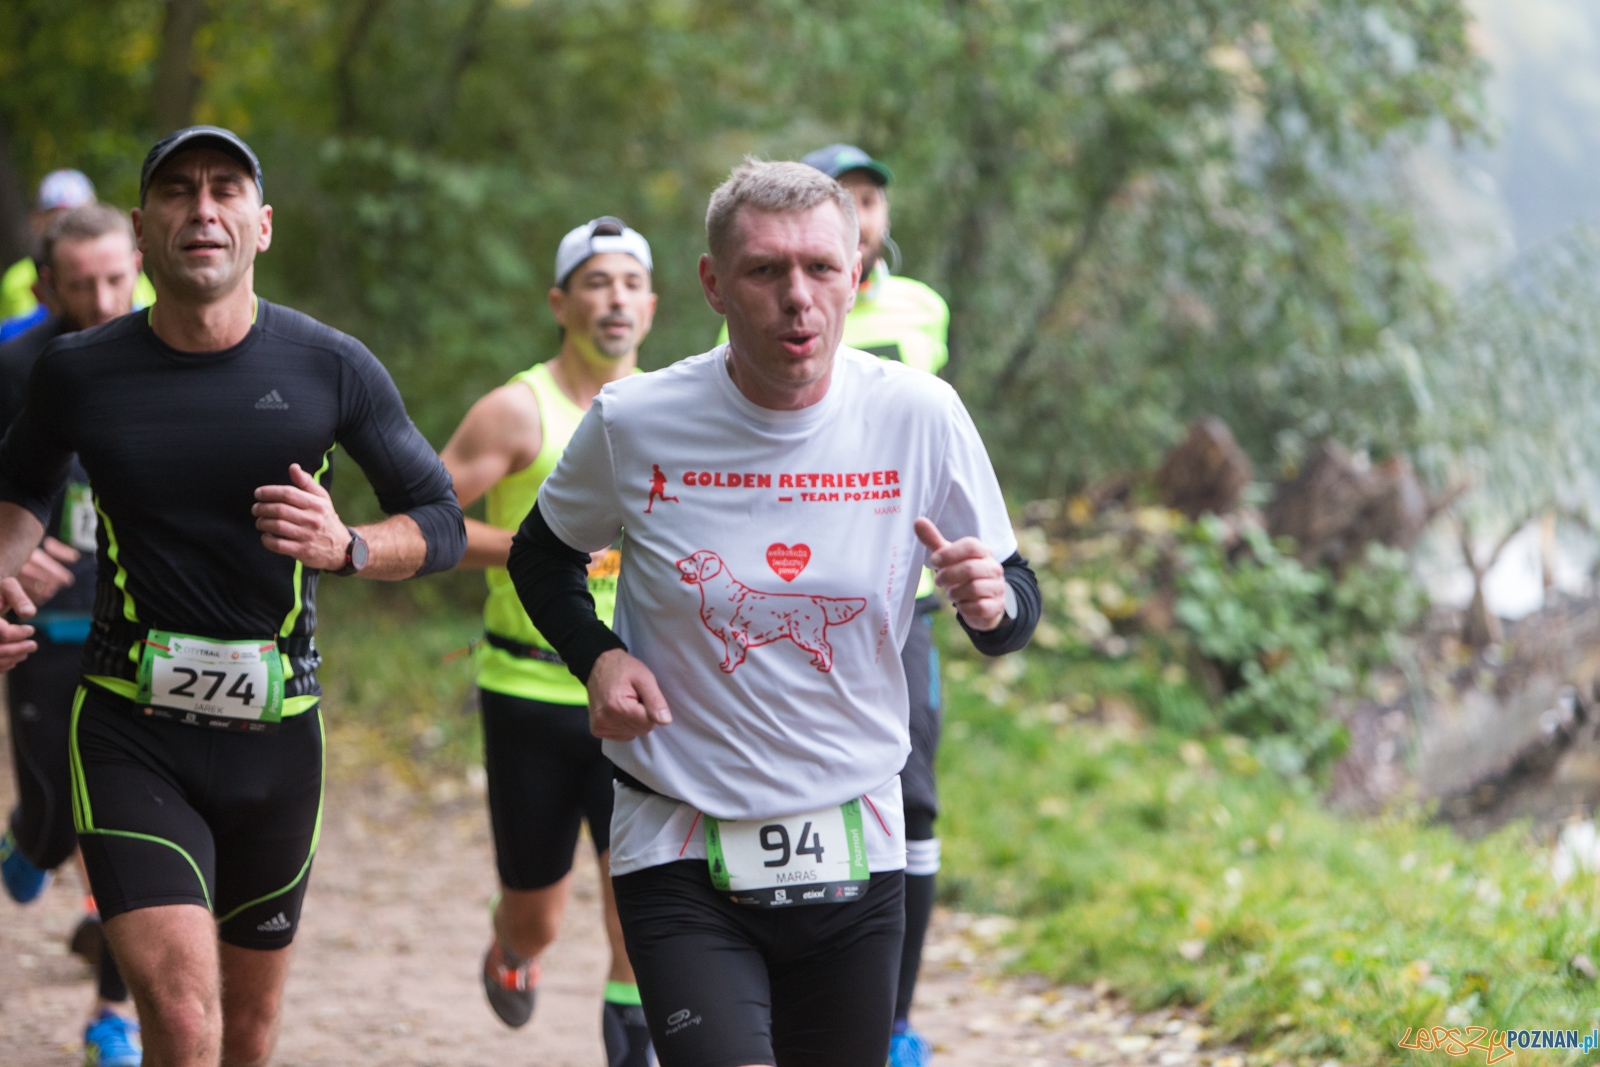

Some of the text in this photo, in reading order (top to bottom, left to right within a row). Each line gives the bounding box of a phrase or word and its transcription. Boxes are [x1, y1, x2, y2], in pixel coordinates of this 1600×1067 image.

[682, 470, 900, 488] GOLDEN RETRIEVER
[800, 492, 839, 502] TEAM
[169, 667, 255, 706] 274
[194, 703, 224, 714] JAREK
[759, 821, 825, 868] 94
[850, 828, 863, 868] Poznań
[776, 870, 817, 883] MARAS
